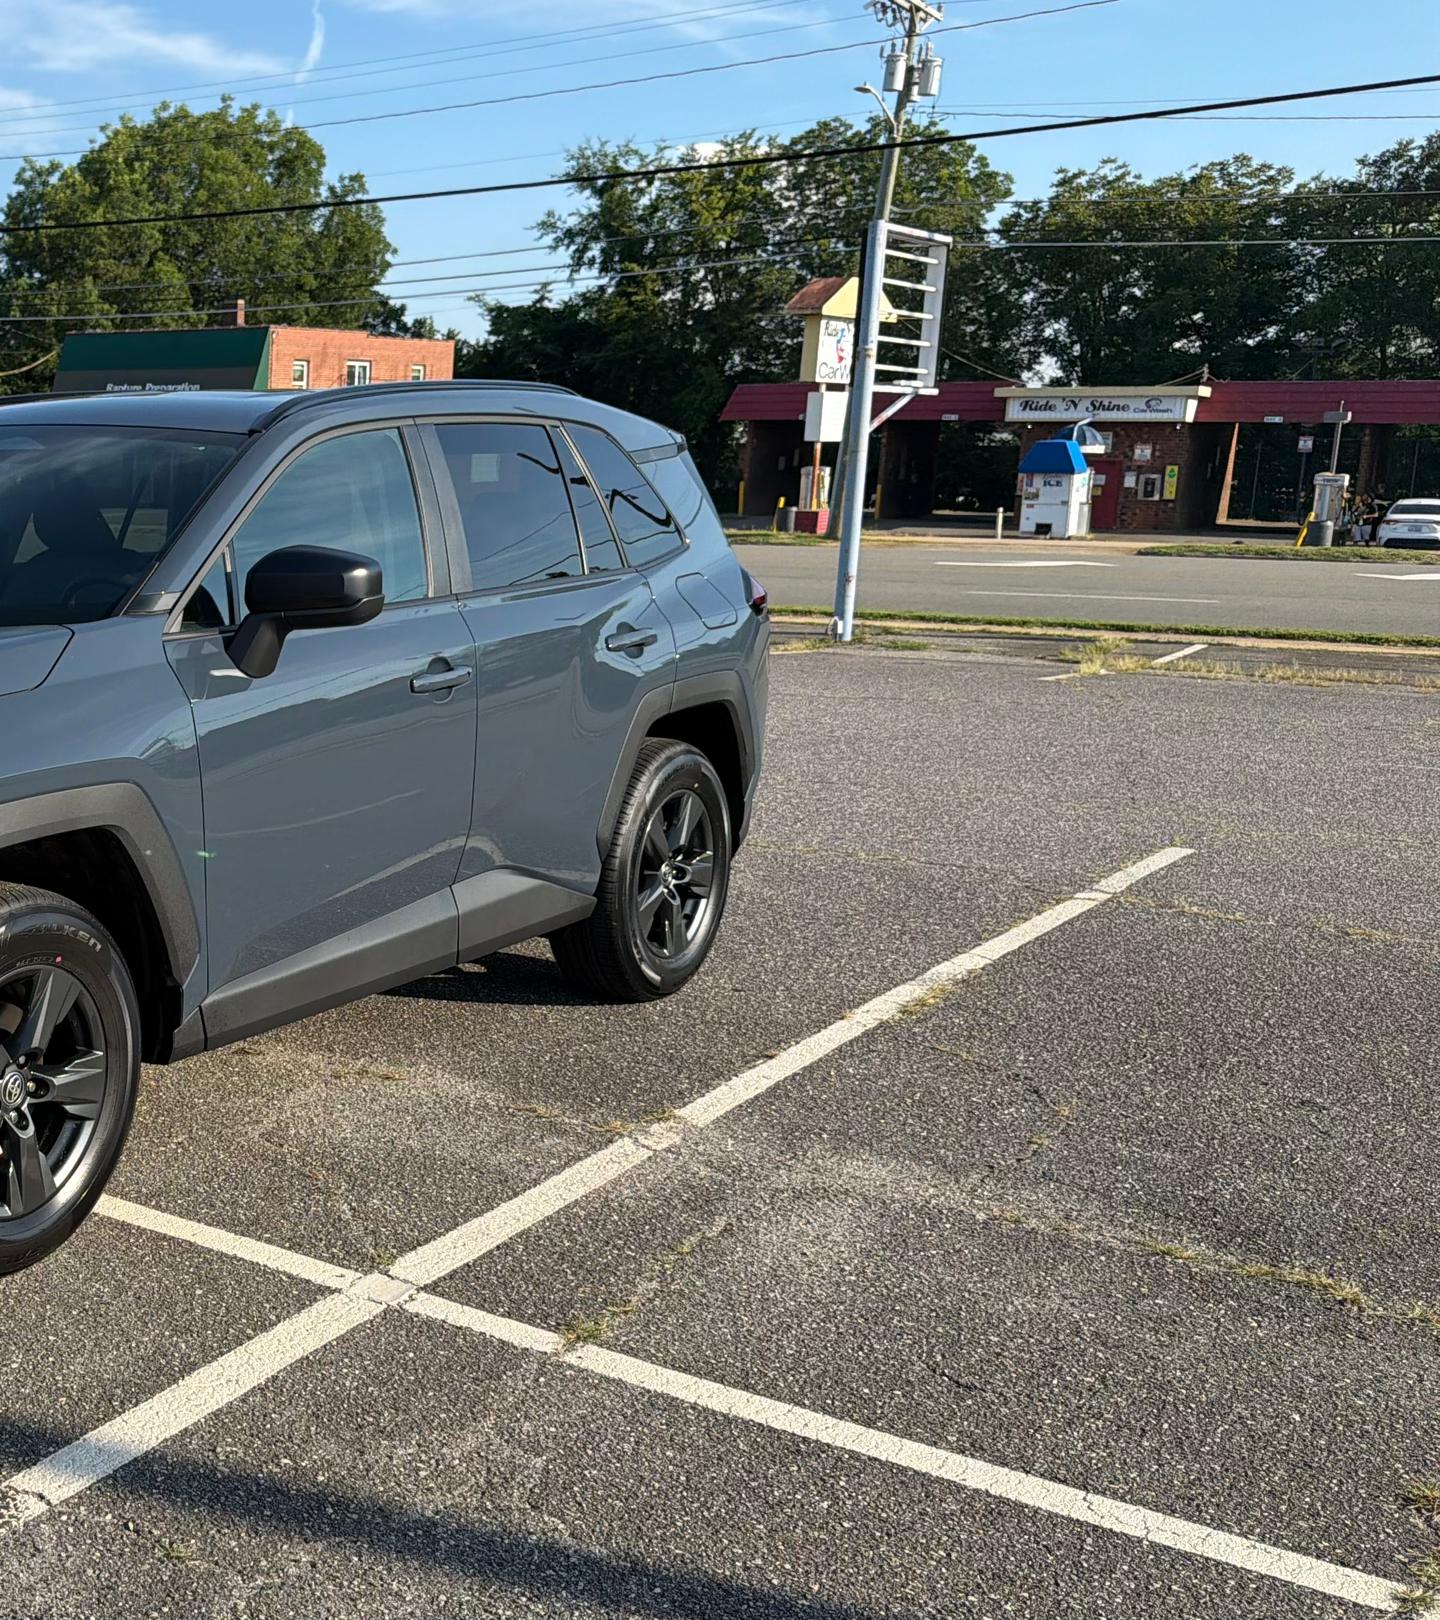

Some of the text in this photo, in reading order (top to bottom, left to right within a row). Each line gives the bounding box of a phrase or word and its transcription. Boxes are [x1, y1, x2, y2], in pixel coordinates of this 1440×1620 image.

[106, 382, 200, 392] Rapture Preparation
[1019, 399, 1056, 412] Ride
[1085, 399, 1131, 412] Shine
[1043, 479, 1063, 487] ICE
